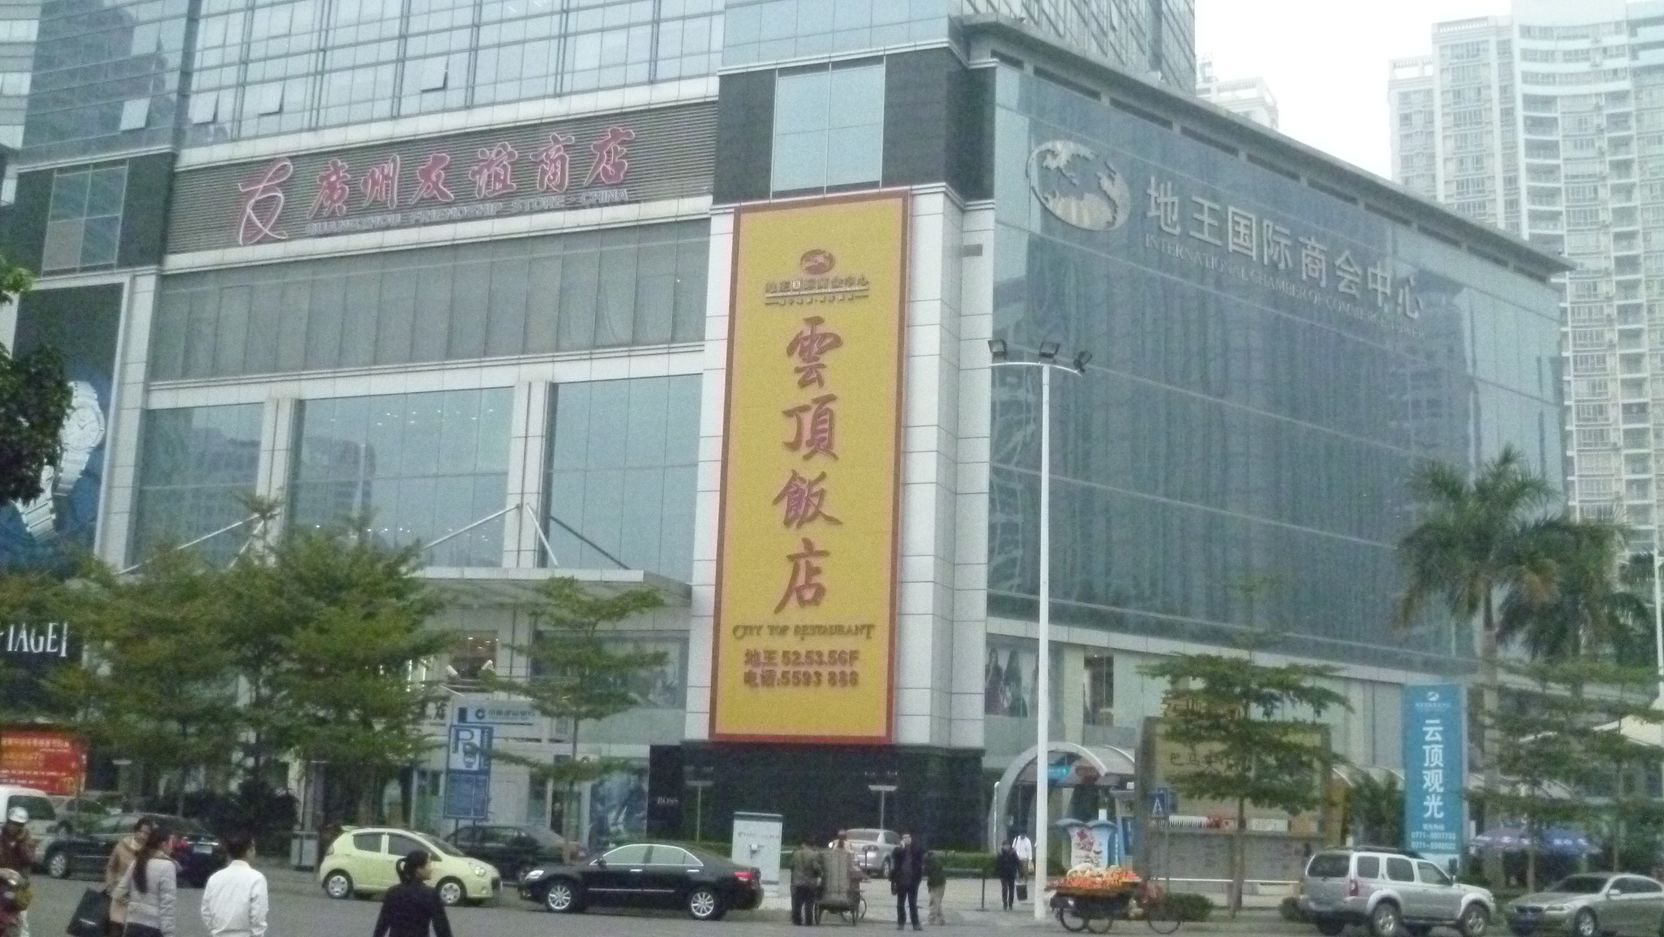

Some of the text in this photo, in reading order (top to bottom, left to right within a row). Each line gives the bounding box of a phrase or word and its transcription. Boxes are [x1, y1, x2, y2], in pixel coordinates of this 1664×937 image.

[581, 189, 629, 205] CHINA
[1145, 233, 1249, 281] INTERNATIONAL
[1146, 176, 1424, 320] 地王国际商会中心
[772, 316, 843, 614] 雲頂飯店
[733, 623, 875, 640] CITY TOP RESTAURANT
[1422, 719, 1445, 818] 云顶观光
